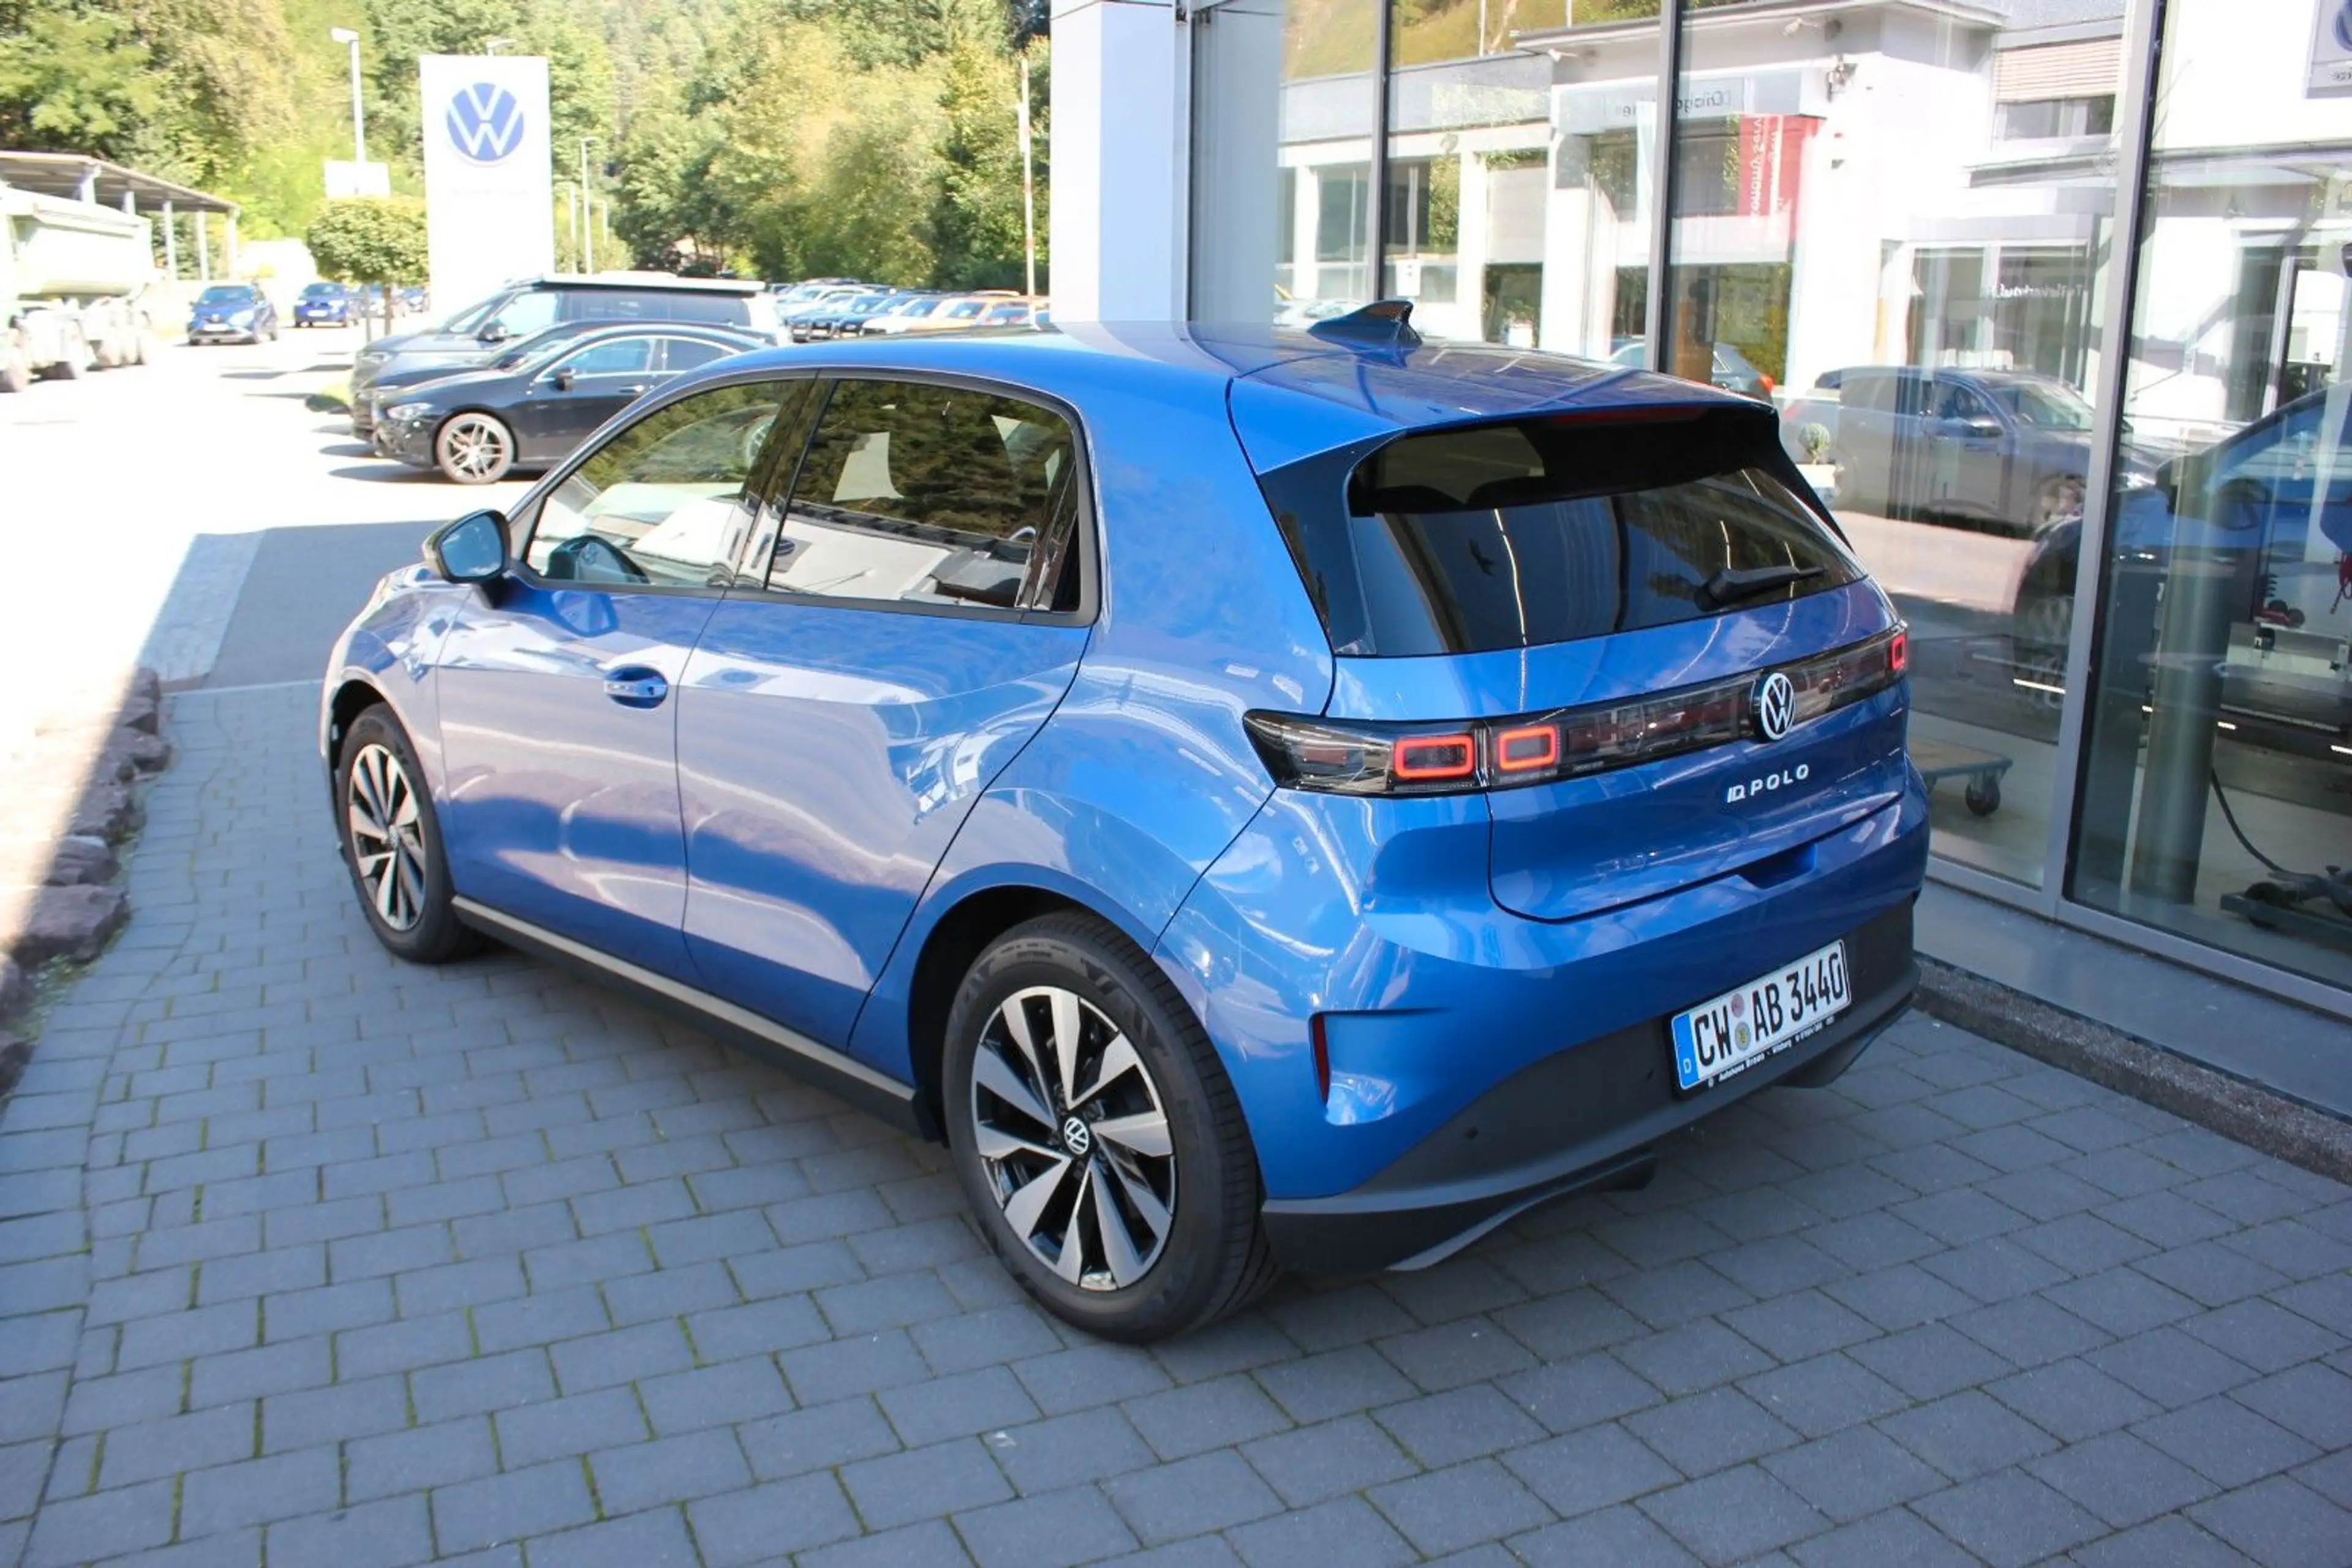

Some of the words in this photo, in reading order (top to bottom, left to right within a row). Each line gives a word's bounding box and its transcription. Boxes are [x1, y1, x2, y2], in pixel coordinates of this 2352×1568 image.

[446, 83, 524, 162] VW
[1762, 673, 1795, 740] VW
[1751, 764, 1809, 796] POLO
[1694, 1006, 1732, 1067] CW
[1752, 982, 1784, 1042] AB
[1786, 952, 1844, 1022] 3440
